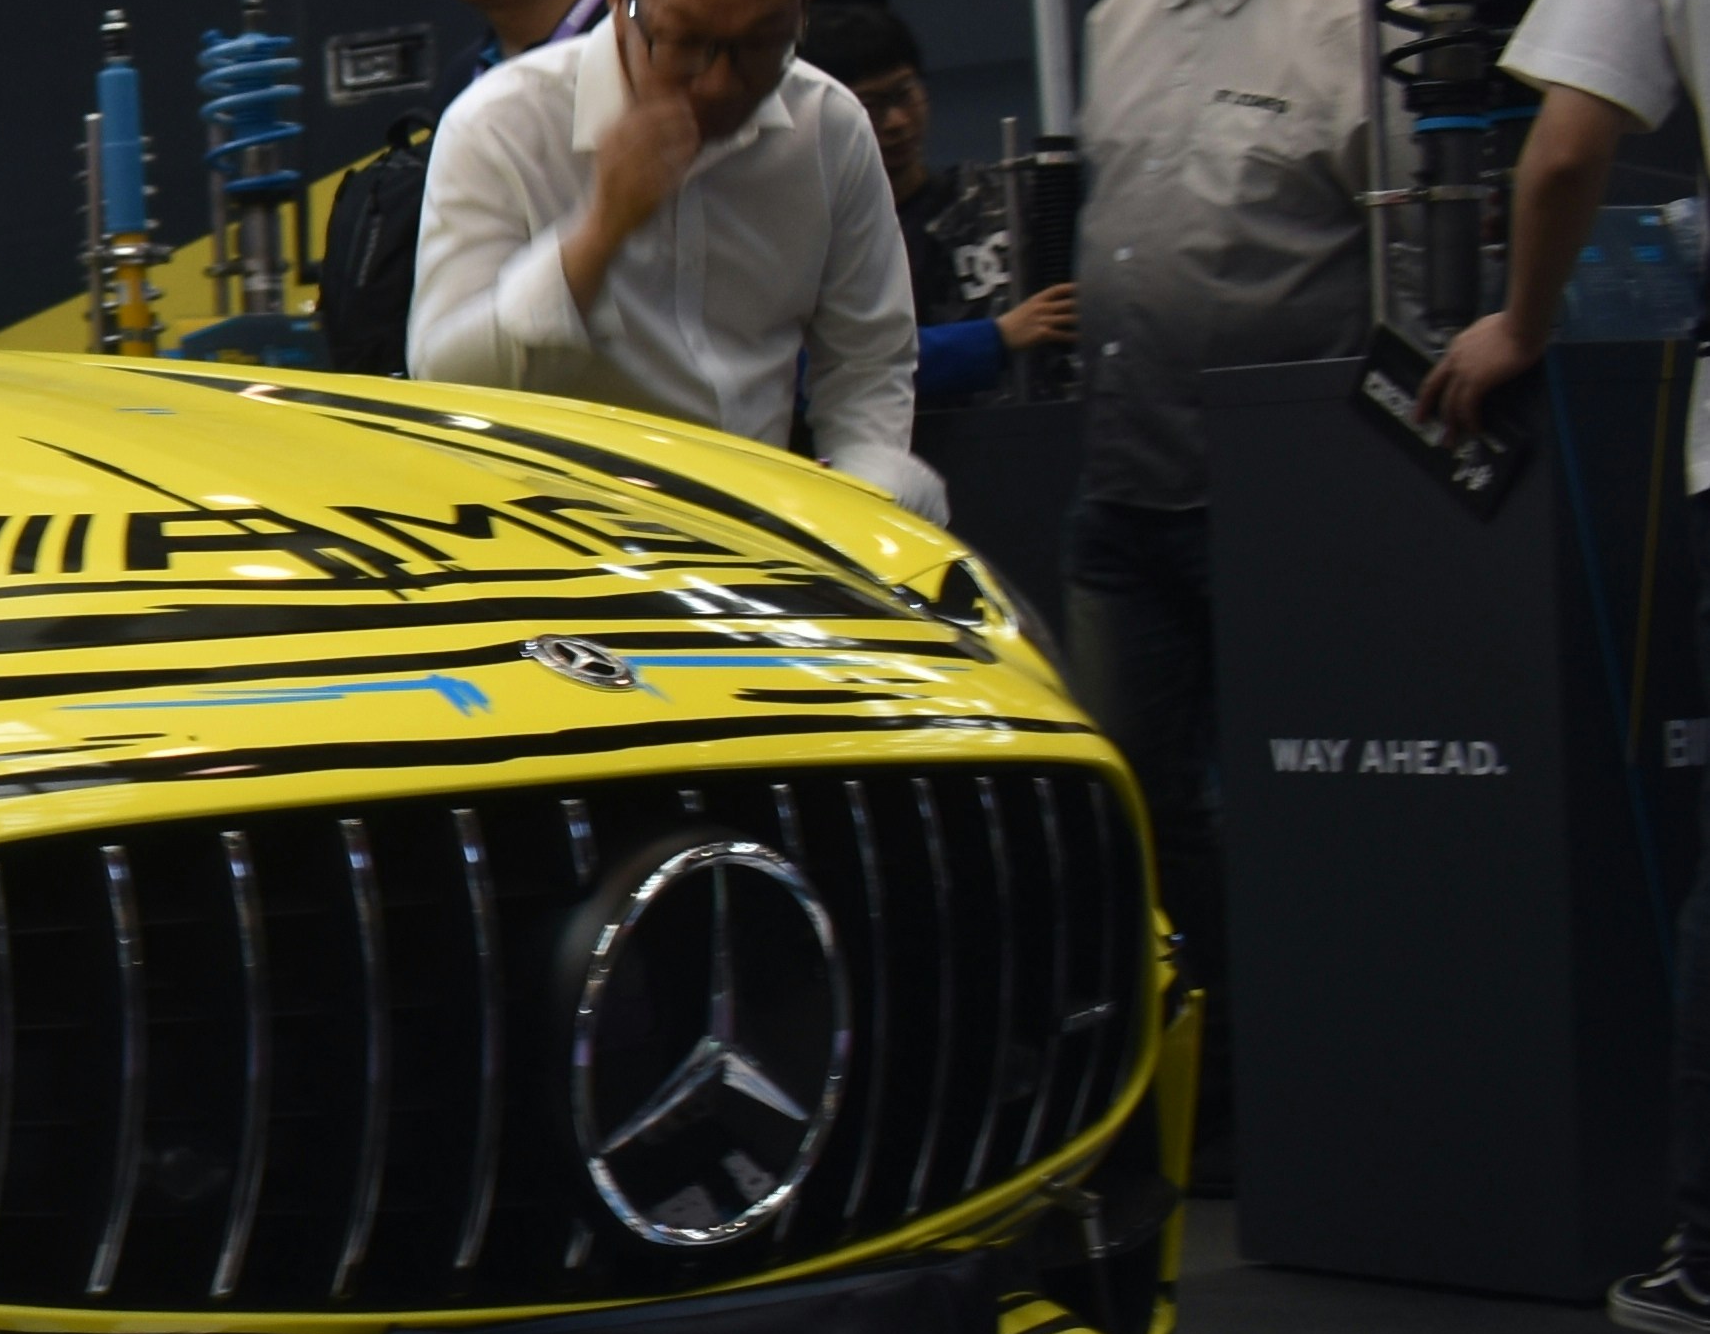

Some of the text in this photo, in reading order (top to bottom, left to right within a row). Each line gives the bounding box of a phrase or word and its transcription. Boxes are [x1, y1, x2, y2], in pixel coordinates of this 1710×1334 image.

[126, 494, 748, 573] AMG
[1269, 739, 1508, 775] WAY AHEAD.
